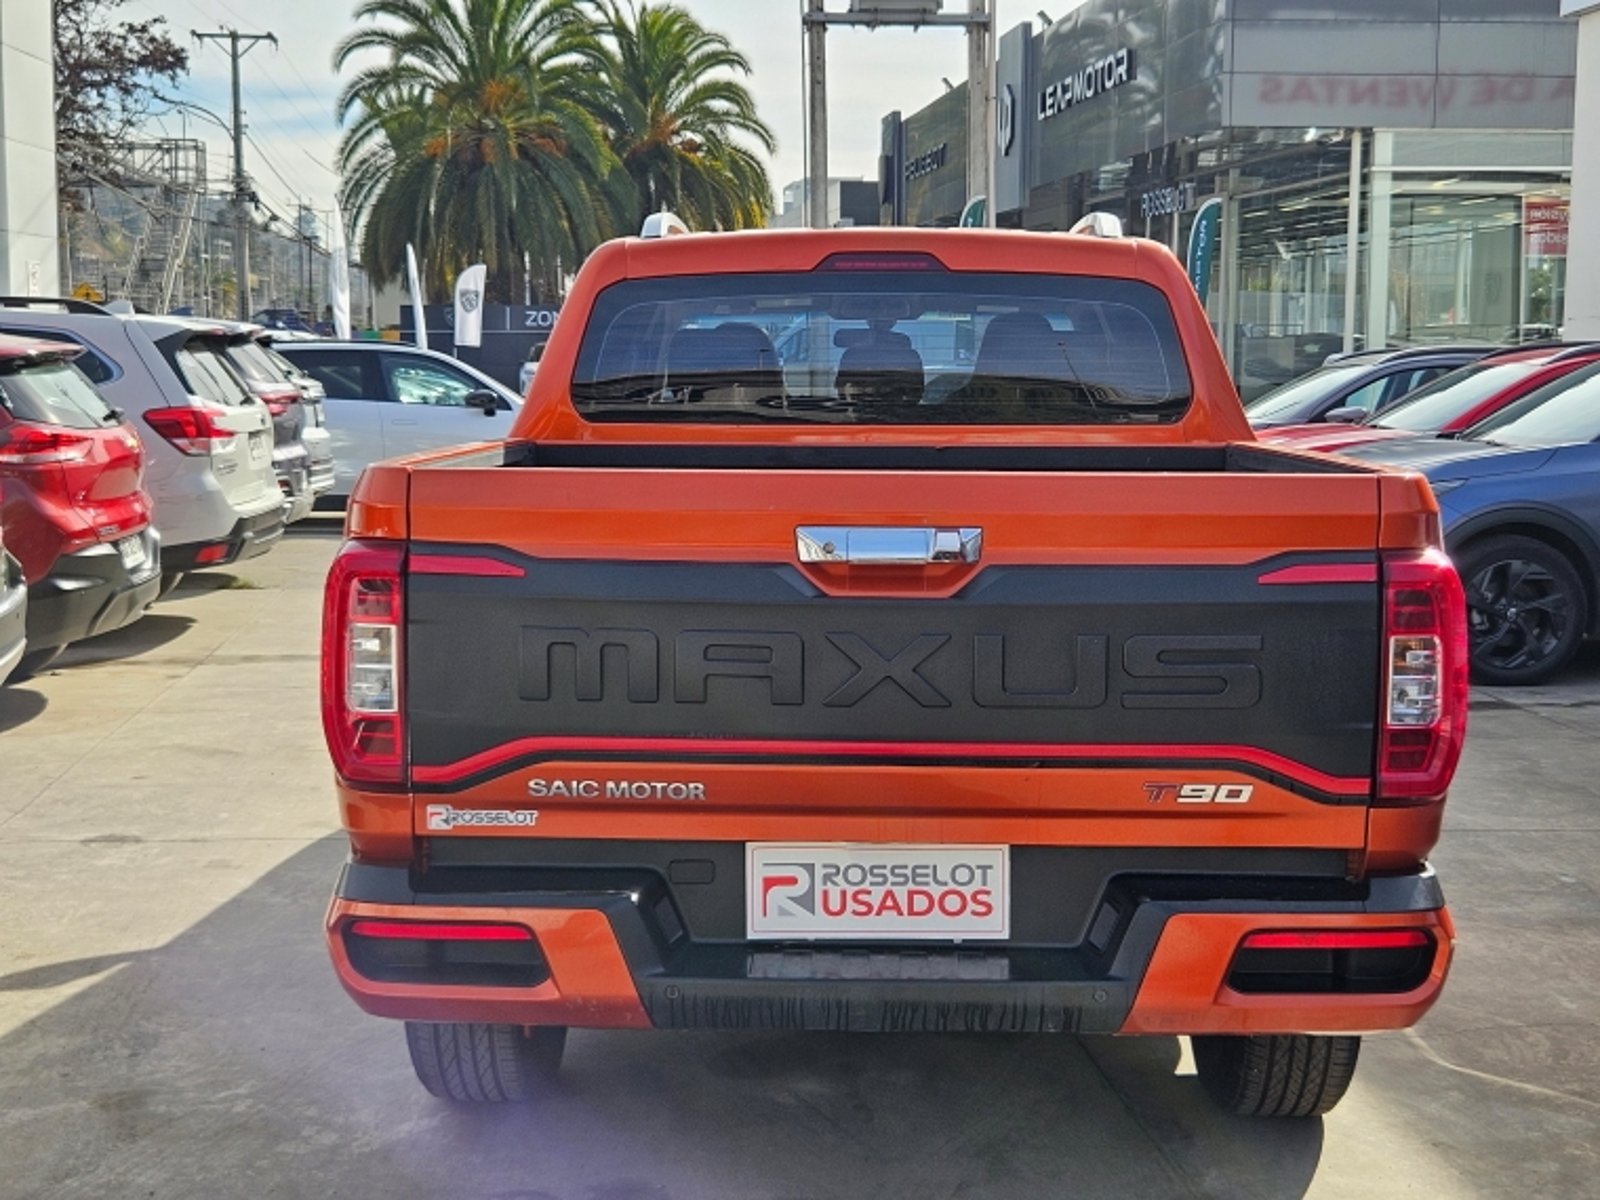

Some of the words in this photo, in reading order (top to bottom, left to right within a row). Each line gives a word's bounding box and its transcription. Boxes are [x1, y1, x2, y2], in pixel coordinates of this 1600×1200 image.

[1037, 47, 1128, 121] LEAPMOTOR
[518, 624, 1264, 709] MAXUS
[527, 778, 600, 798] SAIC
[605, 780, 706, 801] MOTOR
[1142, 782, 1254, 804] T90
[449, 810, 537, 826] ROSSELOT
[821, 862, 994, 888] ROSSELOT
[821, 888, 995, 918] USADOS
